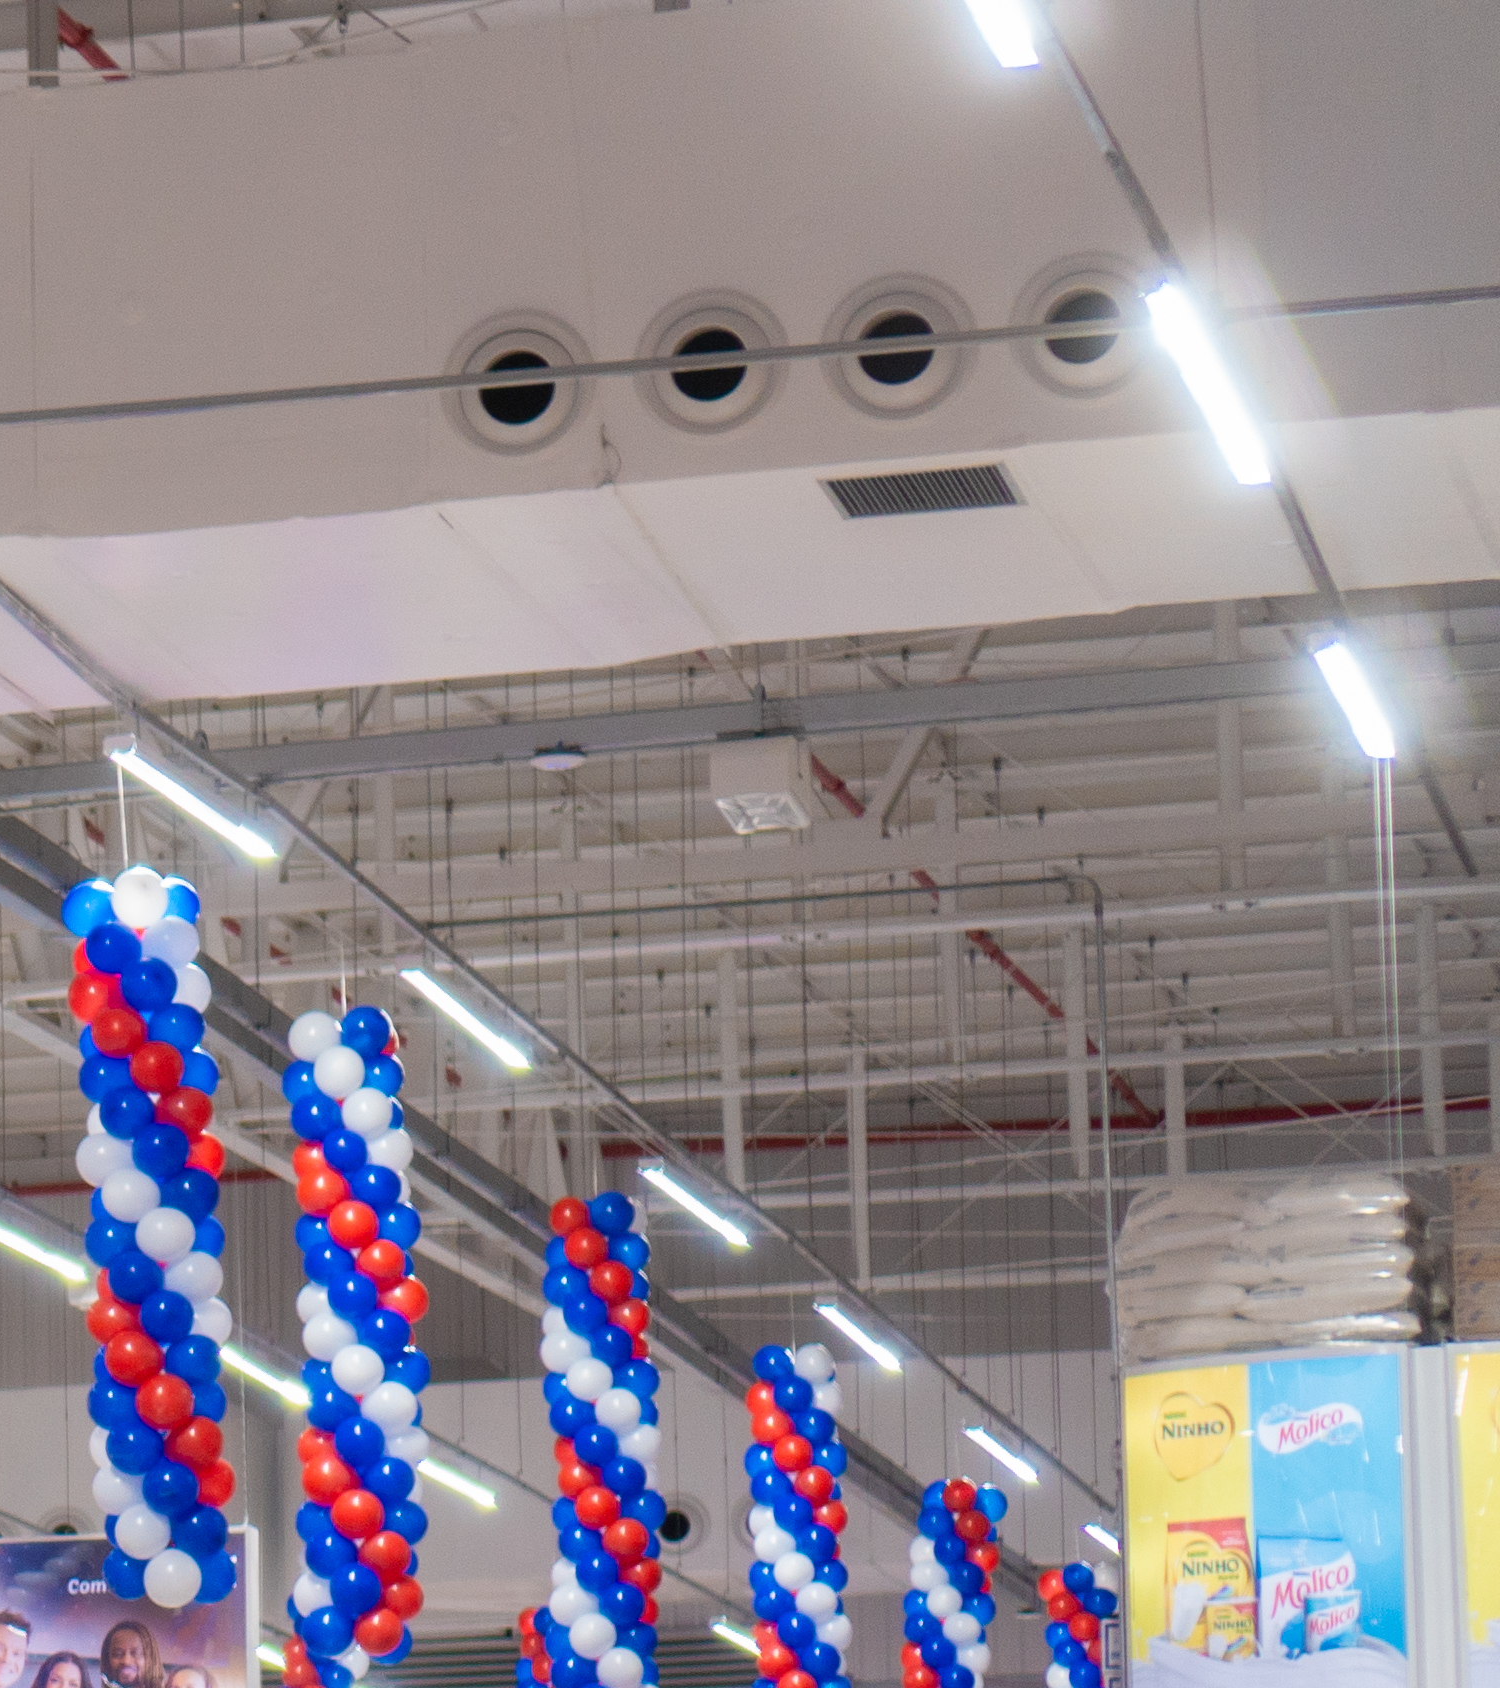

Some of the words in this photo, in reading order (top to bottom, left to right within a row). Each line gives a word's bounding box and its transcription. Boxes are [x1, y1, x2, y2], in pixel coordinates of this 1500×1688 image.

[1162, 1419, 1225, 1441] NINHO
[1277, 1407, 1344, 1453] Molico
[1181, 1558, 1240, 1578] NINHO
